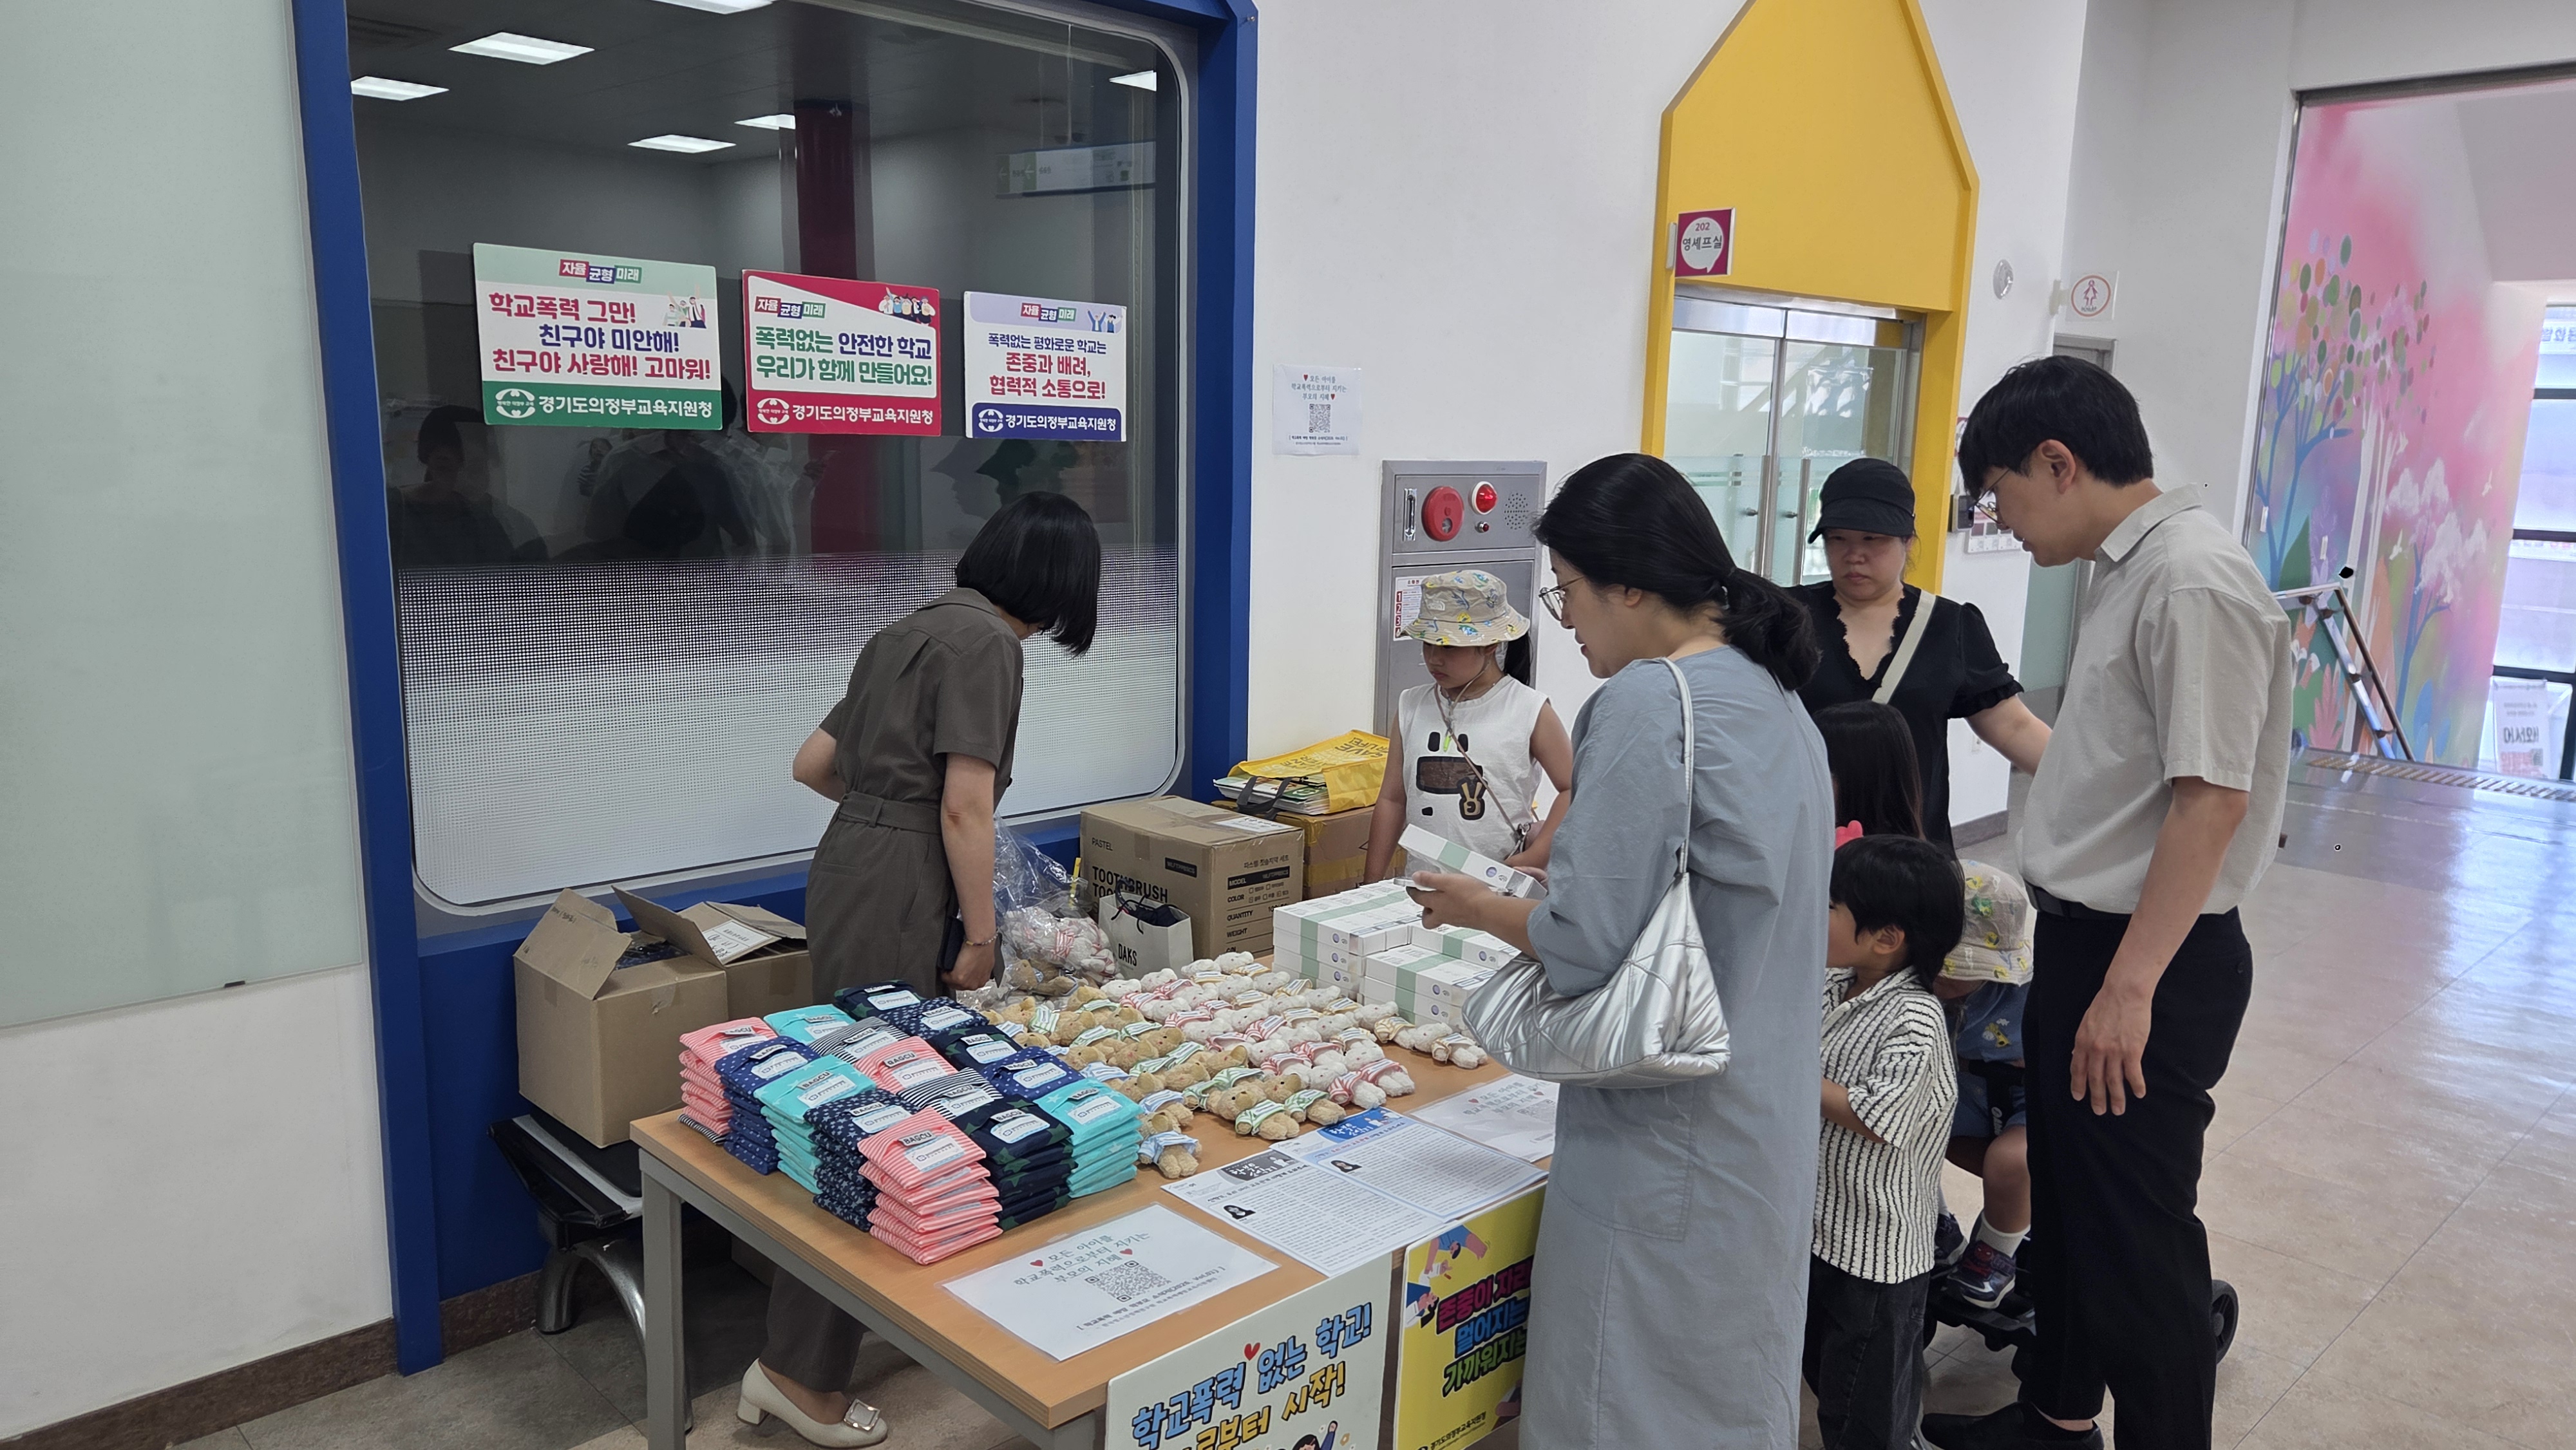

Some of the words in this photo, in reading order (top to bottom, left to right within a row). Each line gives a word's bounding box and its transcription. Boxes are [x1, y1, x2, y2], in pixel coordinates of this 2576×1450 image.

[1695, 222, 1710, 231] 202
[563, 261, 587, 276] 자율
[589, 268, 613, 282] 균형
[616, 268, 639, 281] 미래
[489, 292, 580, 321] 학교폭력
[587, 301, 636, 324] 그만!
[757, 297, 779, 312] 자율
[780, 304, 801, 317] 균형
[804, 303, 824, 317] 미래
[1022, 305, 1039, 316] 자율
[1041, 310, 1057, 321] 균형
[1058, 309, 1075, 320] 미래
[539, 324, 605, 349] 친구야
[611, 331, 679, 353] 미안해!
[755, 326, 833, 353] 폭력없는
[838, 333, 893, 357] 안전한
[897, 337, 932, 359] 학교
[988, 332, 1031, 349] 폭력없는
[1034, 336, 1074, 352] 평화로운
[1077, 339, 1106, 354] 학교는
[493, 348, 561, 373] 친구야
[567, 352, 638, 377] 사랑해!
[645, 357, 710, 380] 고마워!
[756, 355, 815, 380] 우리가
[818, 358, 855, 382] 함께
[858, 362, 932, 386] 만들어요!
[1006, 352, 1054, 374] 존중과
[1057, 355, 1091, 377] 배려,
[989, 375, 1037, 397] 협력적
[1042, 378, 1106, 399] 소통으로!
[538, 396, 712, 418] 경기도의정부교육지원청
[792, 405, 933, 425] 경기도의정부교육지원청
[1005, 414, 1116, 431] 경기도의정부교육지원청
[1334, 743, 1383, 758] SAVE
[1092, 838, 1113, 851] PASTEL
[1092, 866, 1168, 903] TOOTHBRUSH
[1229, 878, 1246, 887] MODEL
[1227, 894, 1244, 903] COLOR
[1227, 910, 1253, 921] QUANTITY
[1227, 928, 1247, 937] WEIGHT
[966, 1035, 990, 1044] BAGCU
[887, 1052, 916, 1065] BAGCU
[802, 1071, 830, 1088] BAGCU
[853, 1103, 882, 1115] BAGCU
[996, 1110, 1023, 1122] BAGCU
[903, 1131, 932, 1144] BAGCU
[1014, 1246, 1112, 1285] 학교폭력으로부터
[1113, 1233, 1150, 1248] 지키는
[1048, 1249, 1074, 1263] 모든
[1076, 1235, 1114, 1250] 아이를
[1054, 1265, 1094, 1283] 부모의
[1095, 1254, 1123, 1266] 지혜
[1436, 1274, 1495, 1335] 존중이
[1454, 1296, 1529, 1359] 멀어지는
[1443, 1328, 1527, 1397] 가까워지는
[1132, 1361, 1247, 1450] 학교폭력
[1257, 1335, 1307, 1395] 없는
[1316, 1302, 1372, 1359] 학교!
[1182, 1406, 1271, 1450] 로부터
[1282, 1361, 1346, 1421] 시작!
